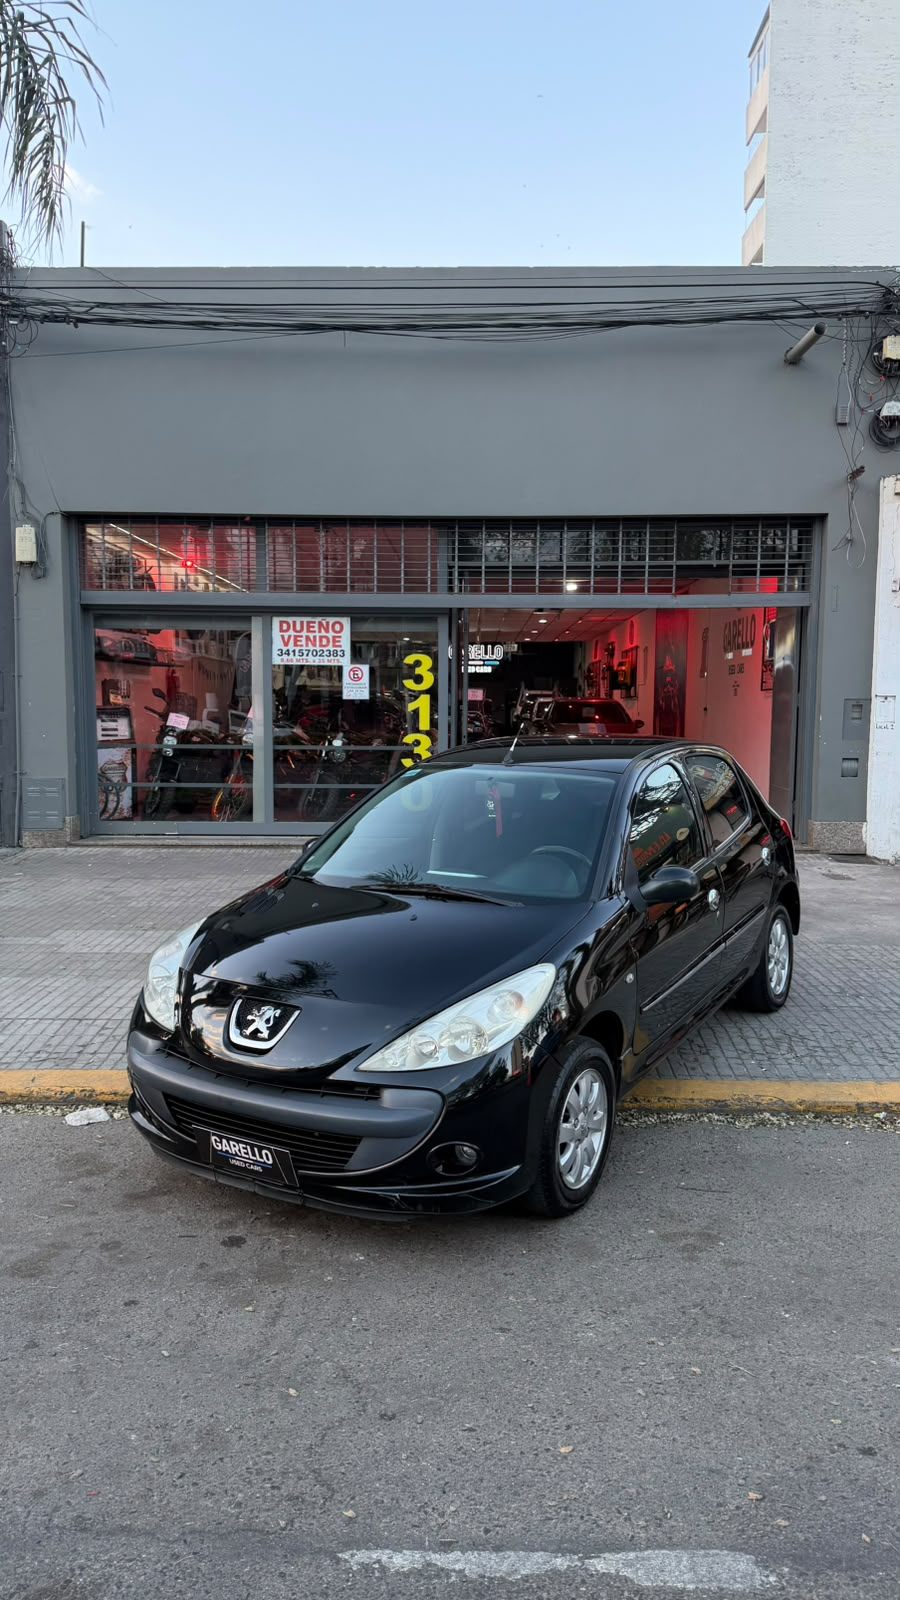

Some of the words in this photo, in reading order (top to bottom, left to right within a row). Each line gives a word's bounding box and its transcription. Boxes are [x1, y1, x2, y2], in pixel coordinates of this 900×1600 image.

[279, 618, 344, 634] DUEÑO
[280, 635, 343, 648] VENDE
[277, 648, 346, 658] 3415702383
[211, 1136, 273, 1164] GARELLO
[229, 1158, 245, 1167] USED
[246, 1163, 263, 1173] CARS
